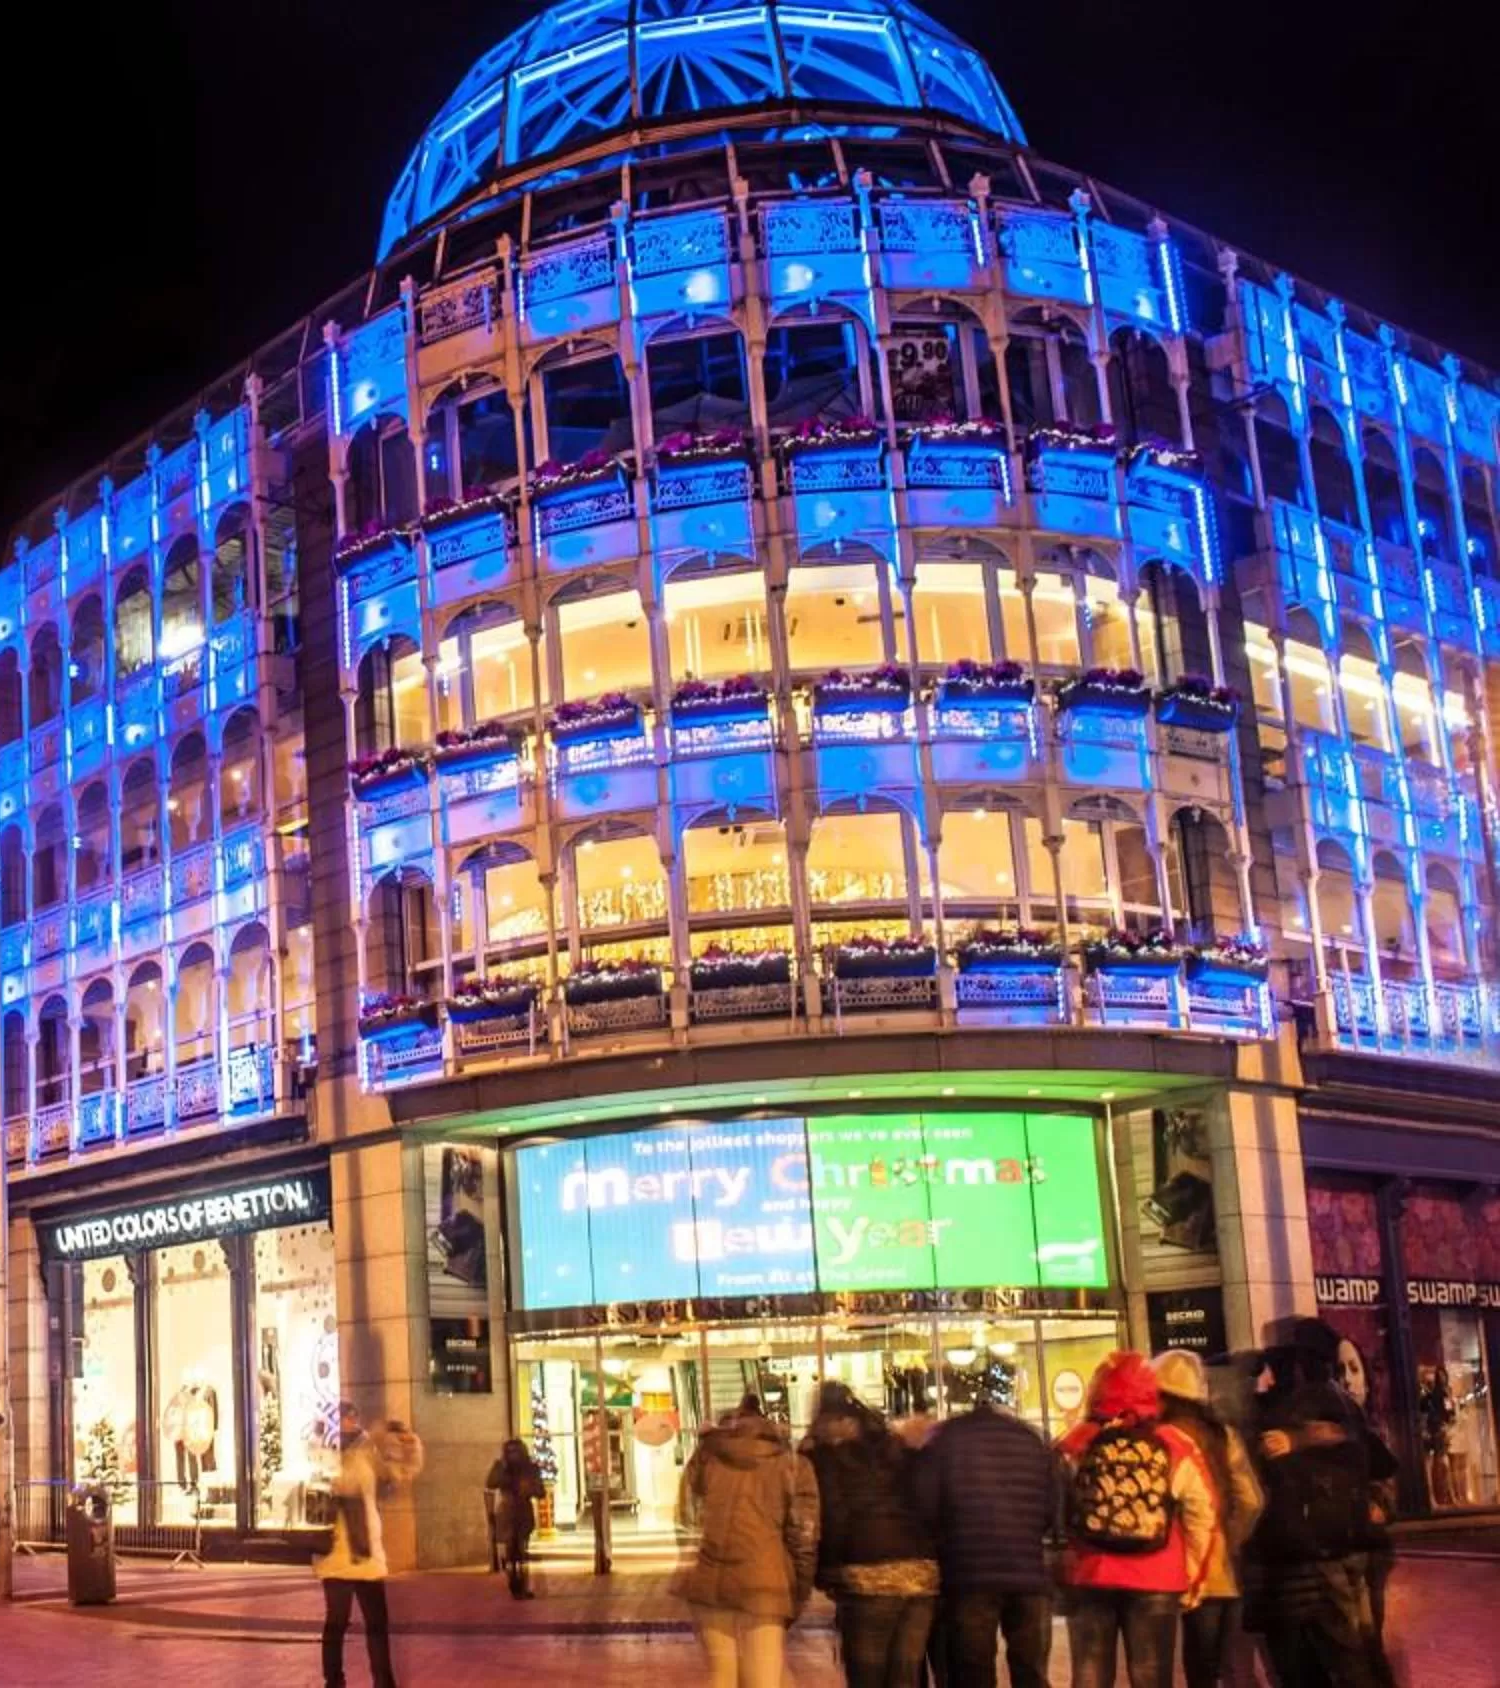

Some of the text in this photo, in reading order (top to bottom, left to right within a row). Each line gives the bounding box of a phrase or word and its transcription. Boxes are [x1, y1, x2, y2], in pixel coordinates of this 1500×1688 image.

[657, 1139, 686, 1153] the
[689, 1133, 750, 1152] jolliest
[755, 1131, 834, 1147] shoppers
[891, 1127, 928, 1142] ever
[932, 1126, 974, 1141] seen
[770, 1151, 1048, 1192] Christmas
[760, 1197, 795, 1213] and
[56, 1219, 113, 1253] UNITED
[112, 1206, 179, 1243] COLORS
[179, 1201, 206, 1233] OF
[1316, 1276, 1380, 1304] wamp
[1407, 1280, 1477, 1306] swamp
